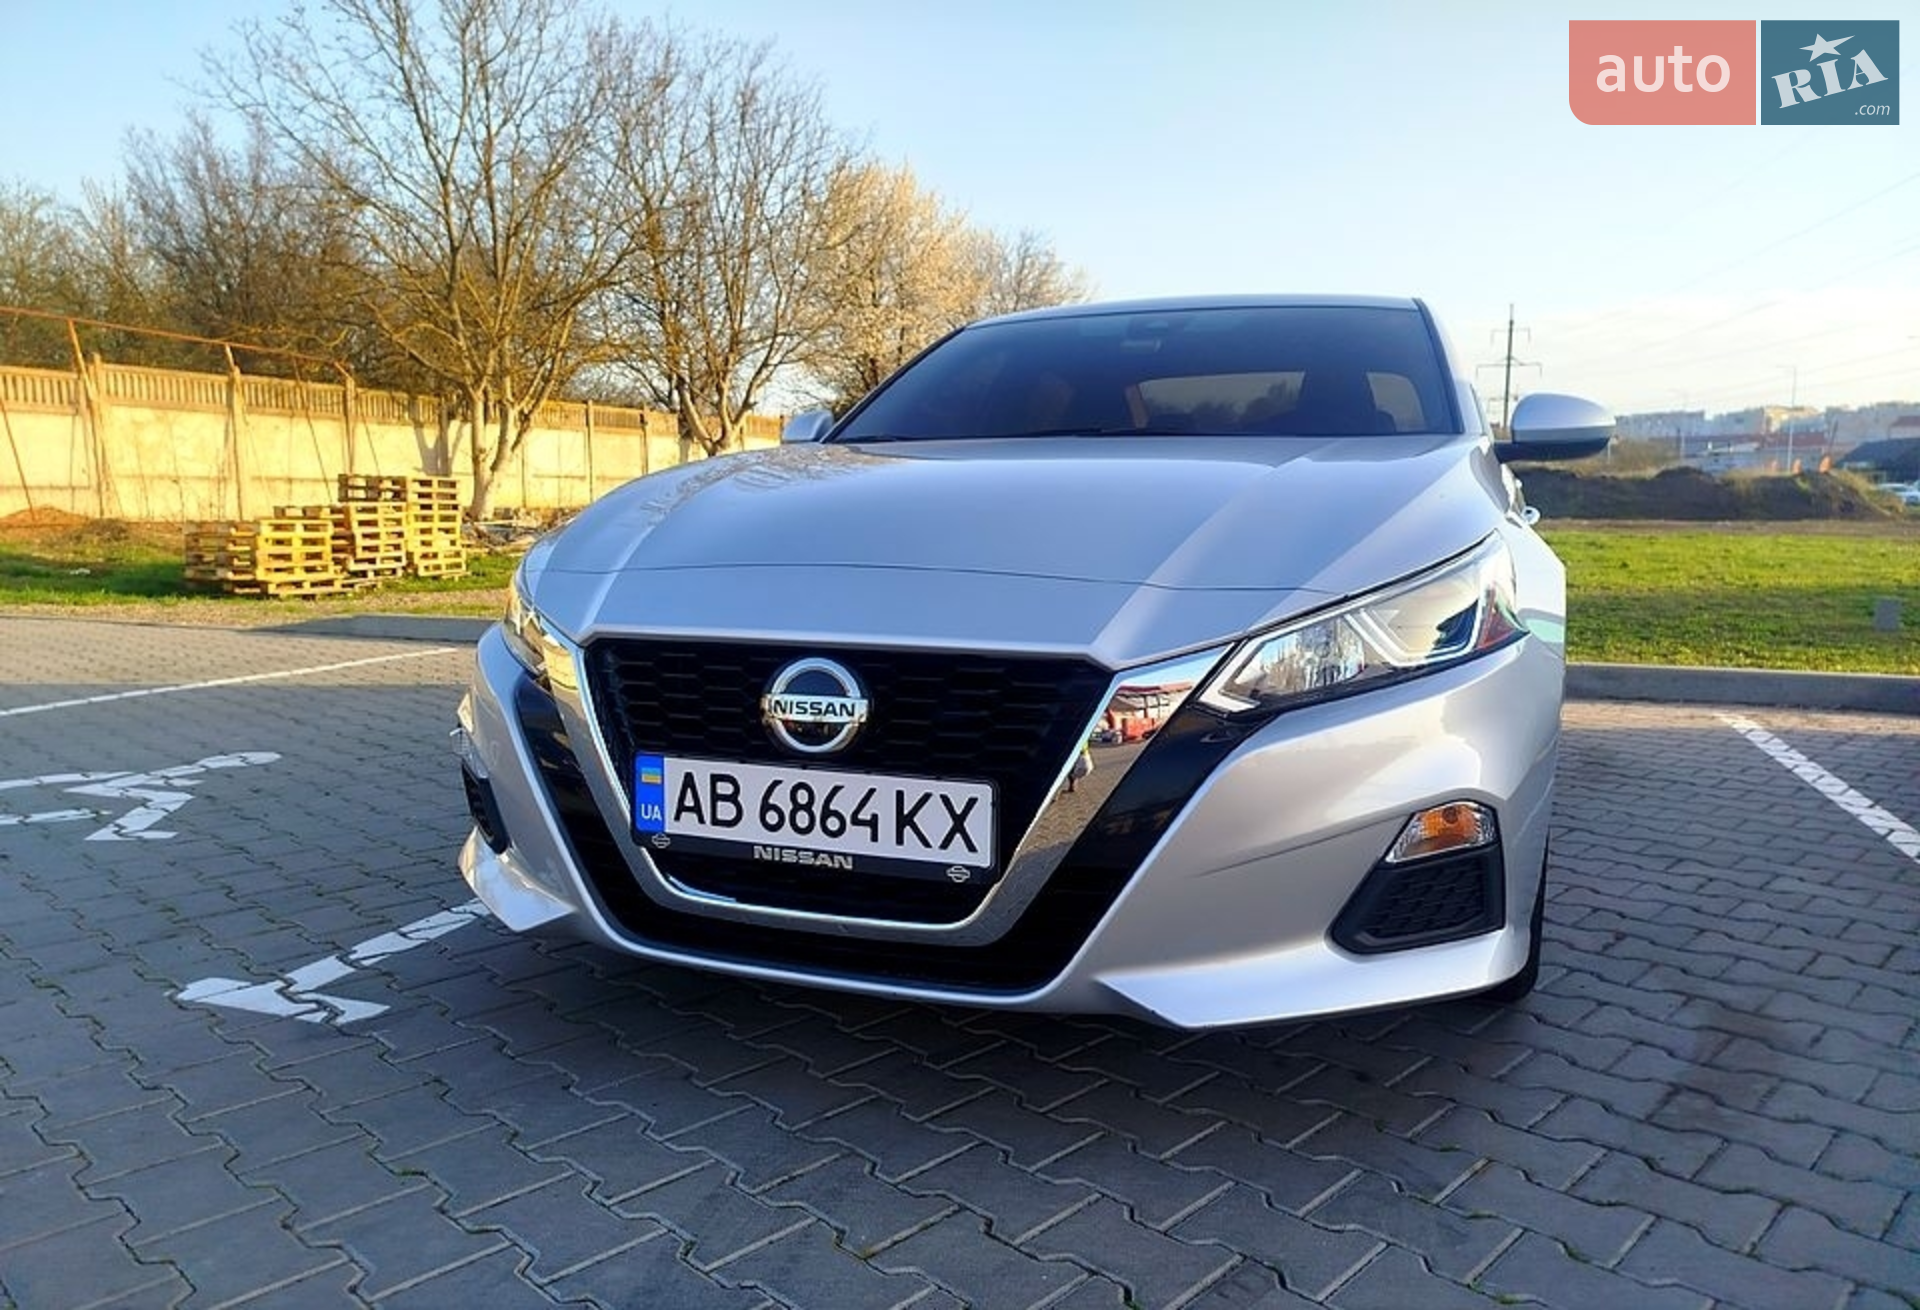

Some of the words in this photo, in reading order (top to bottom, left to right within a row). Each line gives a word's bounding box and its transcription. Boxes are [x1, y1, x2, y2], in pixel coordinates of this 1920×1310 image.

[773, 699, 856, 718] NISSAN
[641, 803, 662, 821] UA
[673, 771, 743, 828] AB
[758, 779, 879, 843] 6864
[895, 789, 979, 853] KX
[752, 845, 853, 870] NISSAN
